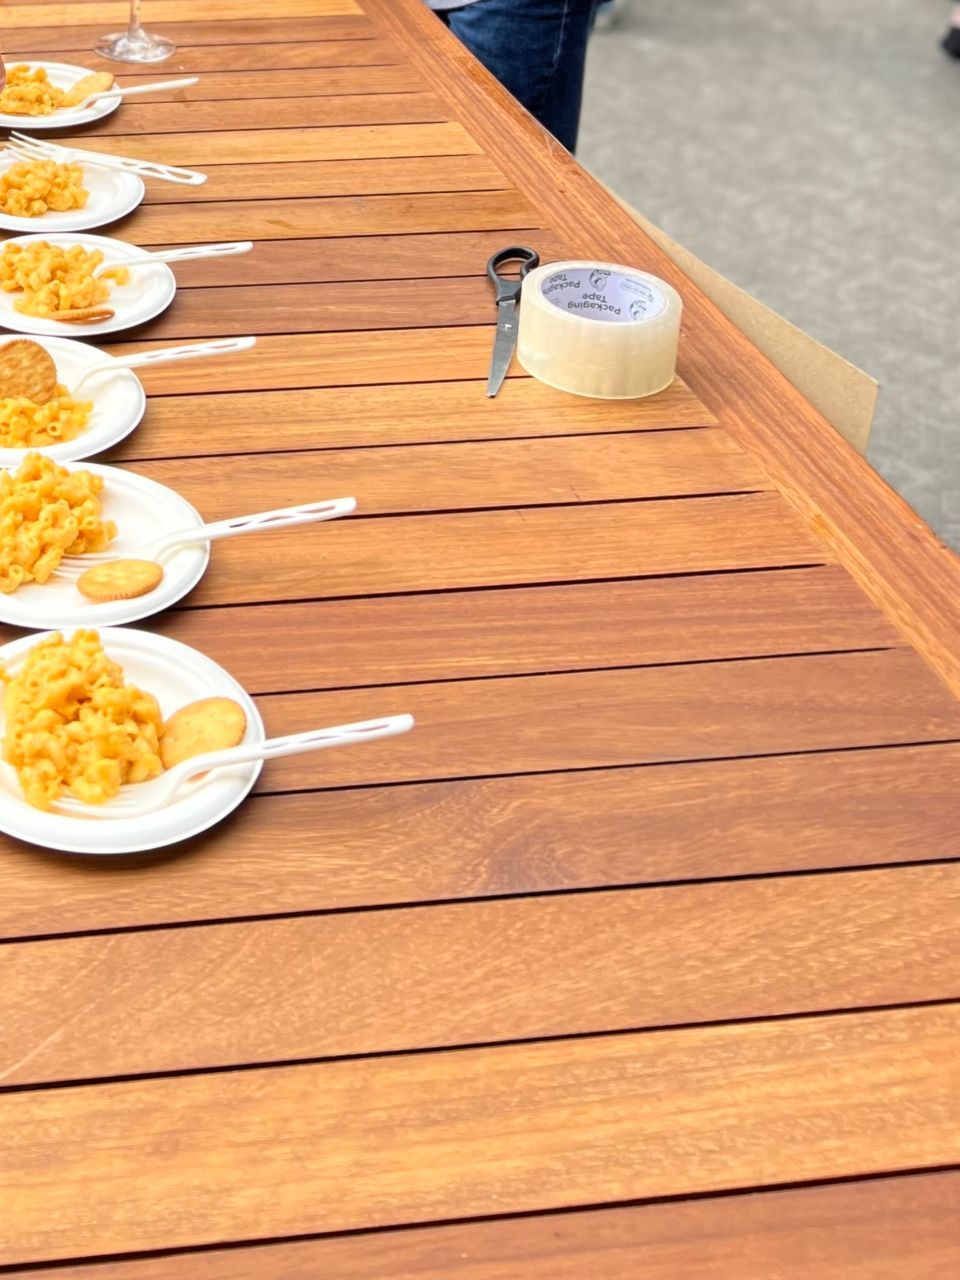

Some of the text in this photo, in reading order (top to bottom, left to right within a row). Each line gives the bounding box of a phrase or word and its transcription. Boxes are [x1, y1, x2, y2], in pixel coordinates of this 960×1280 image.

[549, 273, 568, 284] Tape
[582, 293, 608, 303] Tape
[567, 300, 622, 316] Packaging
